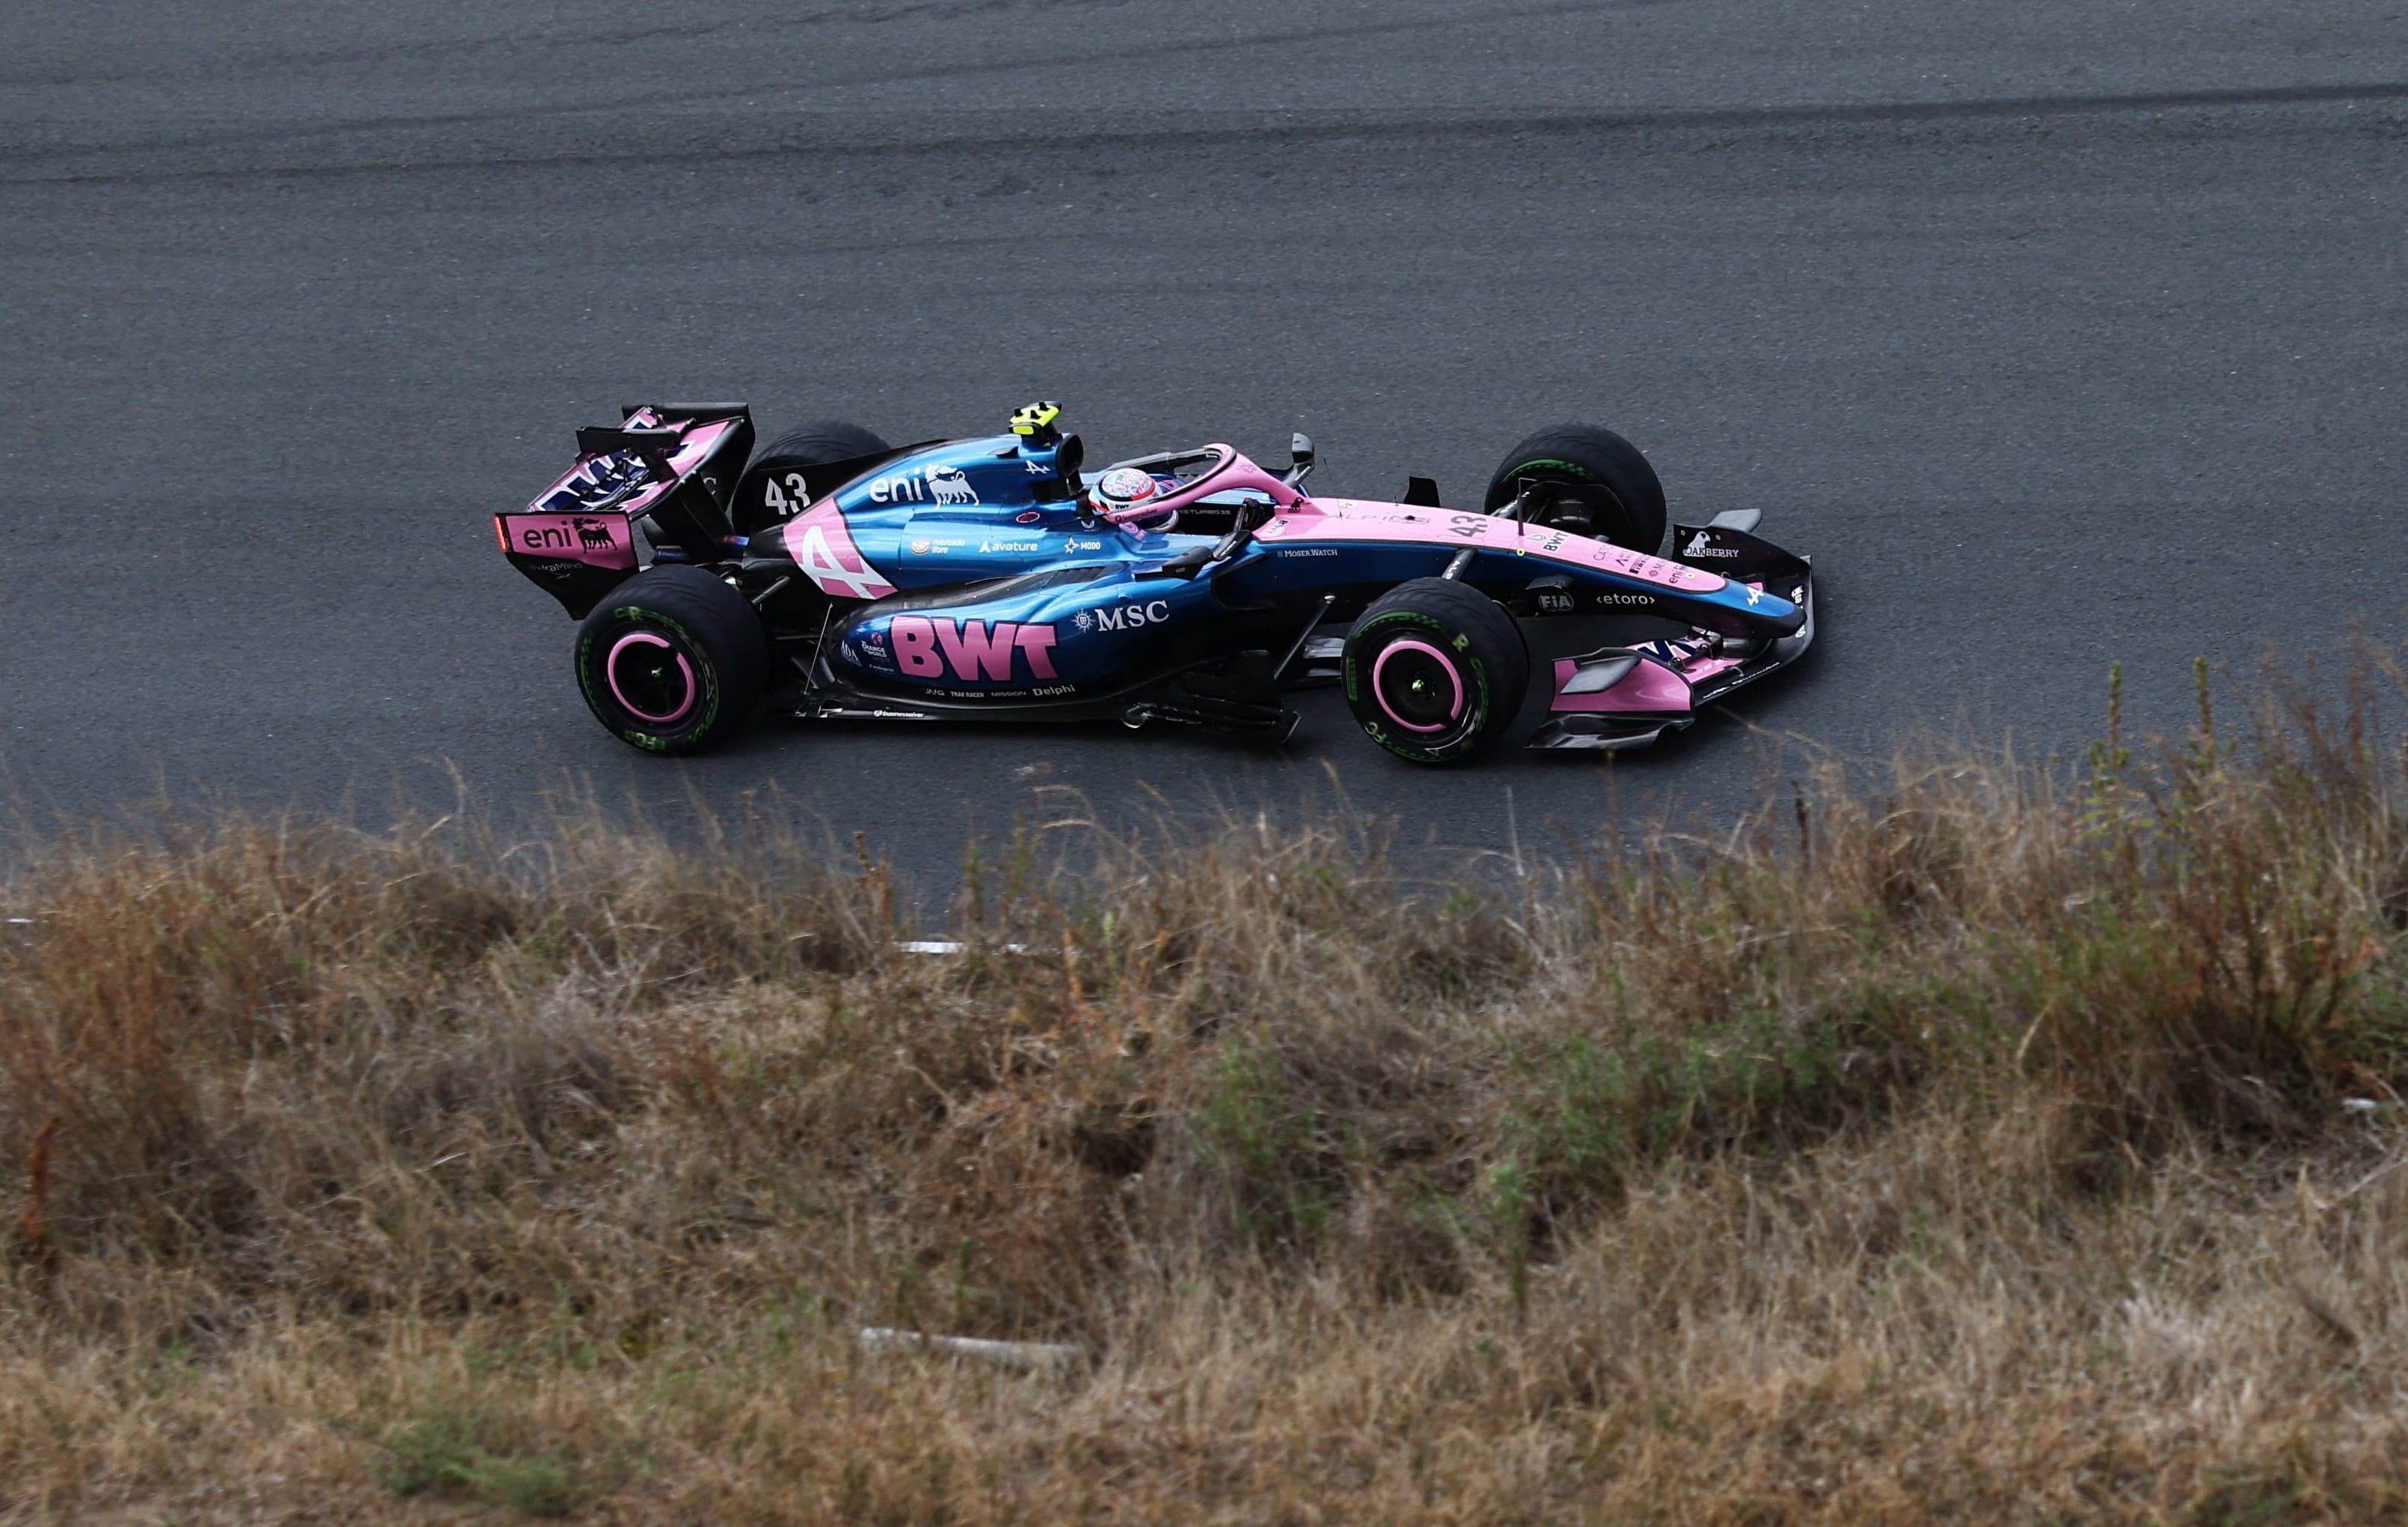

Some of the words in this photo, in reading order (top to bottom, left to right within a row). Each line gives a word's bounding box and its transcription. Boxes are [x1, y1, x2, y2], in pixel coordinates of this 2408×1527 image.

[765, 472, 810, 515] 43
[870, 467, 924, 502] eni
[524, 520, 572, 548] eni
[1447, 515, 1488, 537] 43
[932, 539, 966, 547] mercado
[991, 542, 1038, 551] avature
[1081, 541, 1101, 550] MODO
[1543, 532, 1569, 552] BWT
[1687, 546, 1740, 558] OAKBERRY
[1669, 568, 1685, 584] eni
[1540, 595, 1572, 608] FIA
[1094, 600, 1170, 632] MSC
[891, 615, 1059, 681] BWT
[1031, 684, 1076, 697] Delphi
